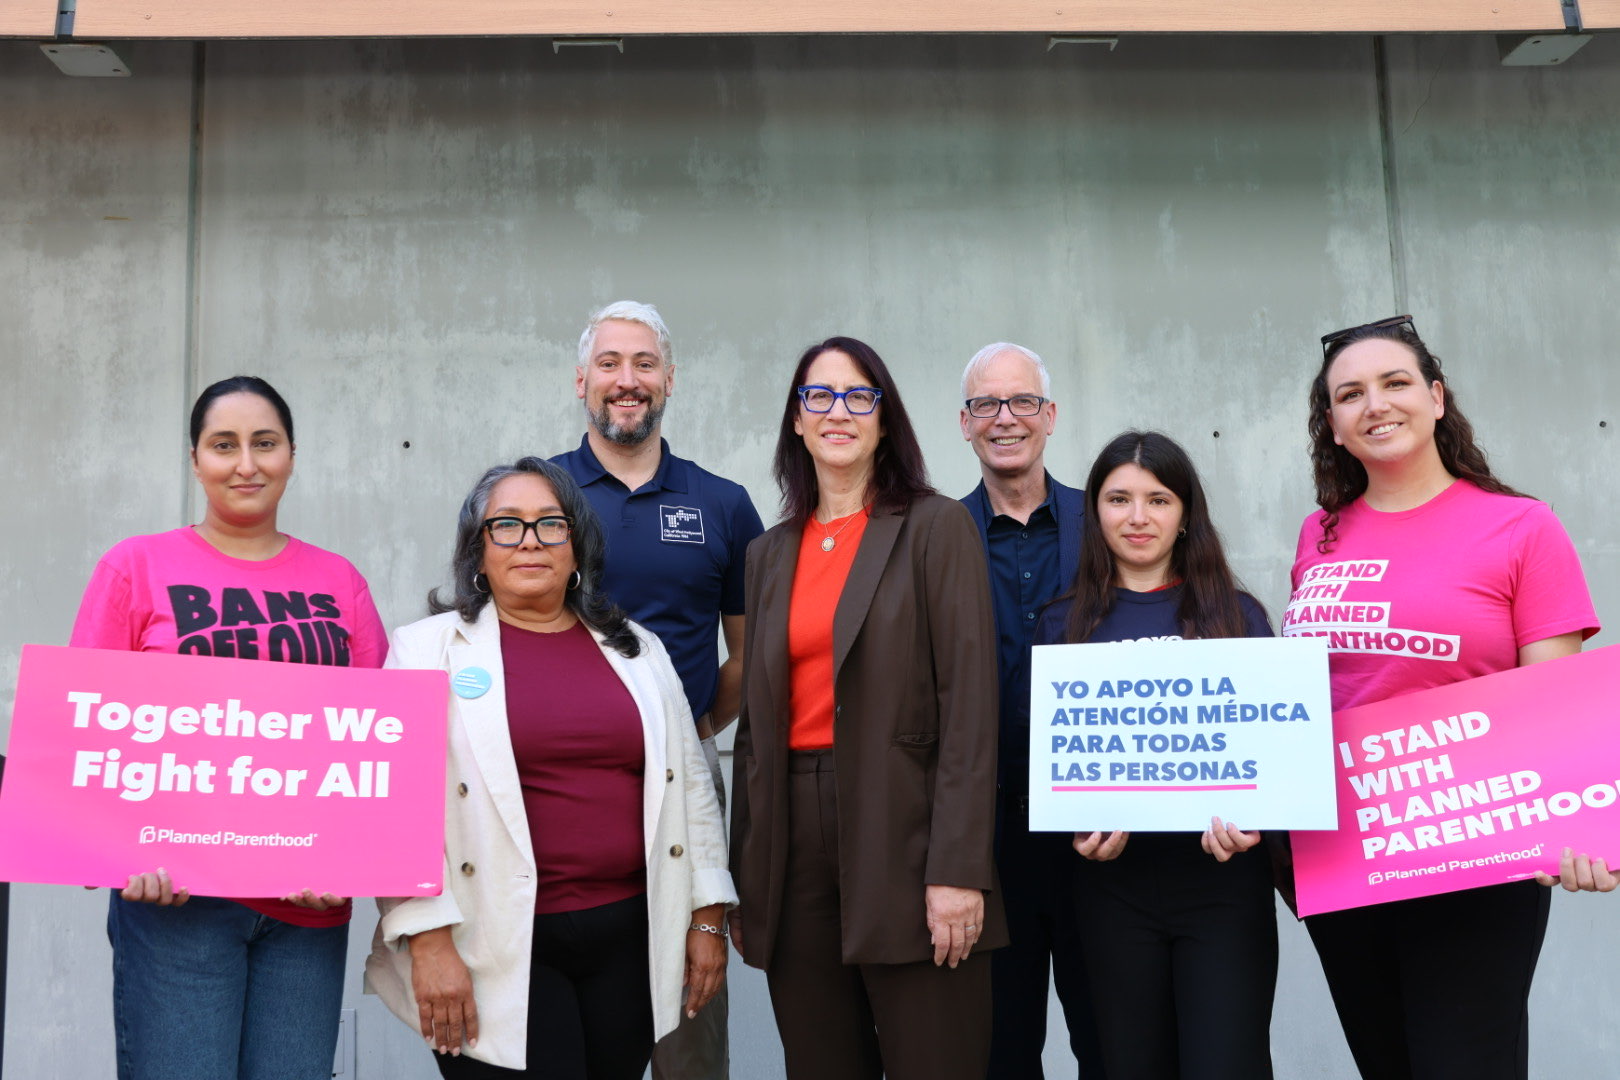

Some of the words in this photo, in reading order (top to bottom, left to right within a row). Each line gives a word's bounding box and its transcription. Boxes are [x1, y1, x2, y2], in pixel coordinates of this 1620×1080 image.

[1308, 563, 1382, 582] STAND
[167, 584, 341, 638] BANS
[1284, 605, 1385, 628] PLANNED
[1050, 680, 1089, 699] YO
[1096, 678, 1194, 698] APOYO
[1201, 677, 1236, 696] LA
[67, 691, 312, 743] Together
[323, 707, 404, 743] We
[1050, 702, 1188, 726] ATENCIÓN
[1197, 700, 1311, 724] MÉDICA
[1051, 735, 1126, 754] PARA
[1132, 732, 1227, 753] TODAS
[1338, 741, 1355, 768] I
[1361, 710, 1491, 763] STAND
[72, 748, 217, 801] Fight
[227, 755, 307, 797] for
[316, 761, 390, 798] All
[1051, 762, 1101, 782] LAS
[1109, 760, 1258, 781] PERSONAS
[1347, 754, 1455, 800] WITH
[1355, 769, 1542, 832] PLANNED
[1361, 779, 1620, 860] PARENTHOO
[157, 829, 221, 845] Planned
[223, 831, 313, 847] Parenthood
[1385, 862, 1447, 882] Planned
[1448, 844, 1542, 872] Parenthood
